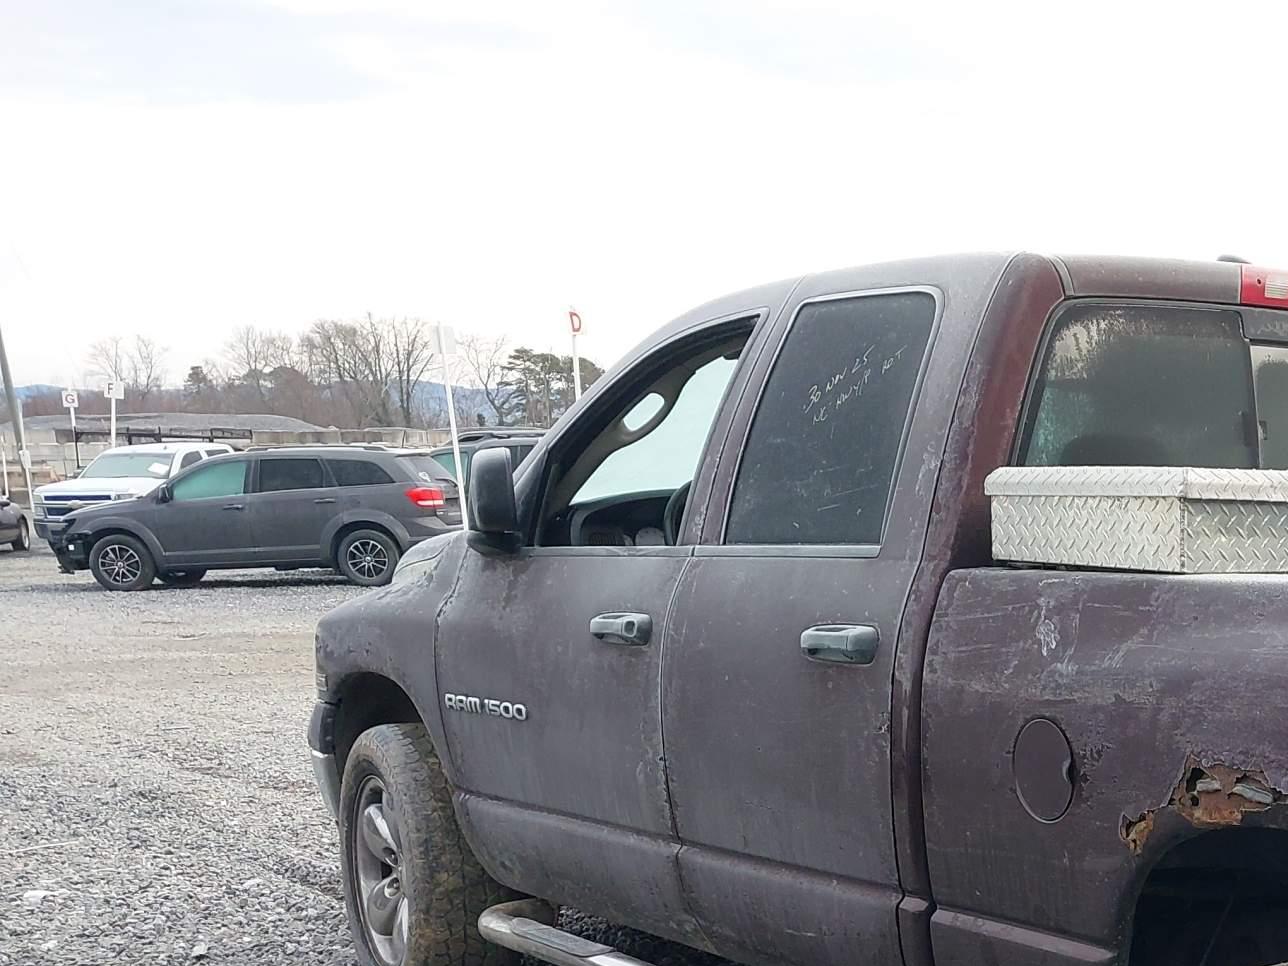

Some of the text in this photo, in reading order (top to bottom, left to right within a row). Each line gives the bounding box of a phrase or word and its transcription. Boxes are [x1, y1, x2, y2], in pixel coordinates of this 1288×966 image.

[569, 311, 582, 333] D
[107, 382, 114, 395] F
[64, 393, 76, 404] G
[444, 693, 528, 721] RAM 1500
